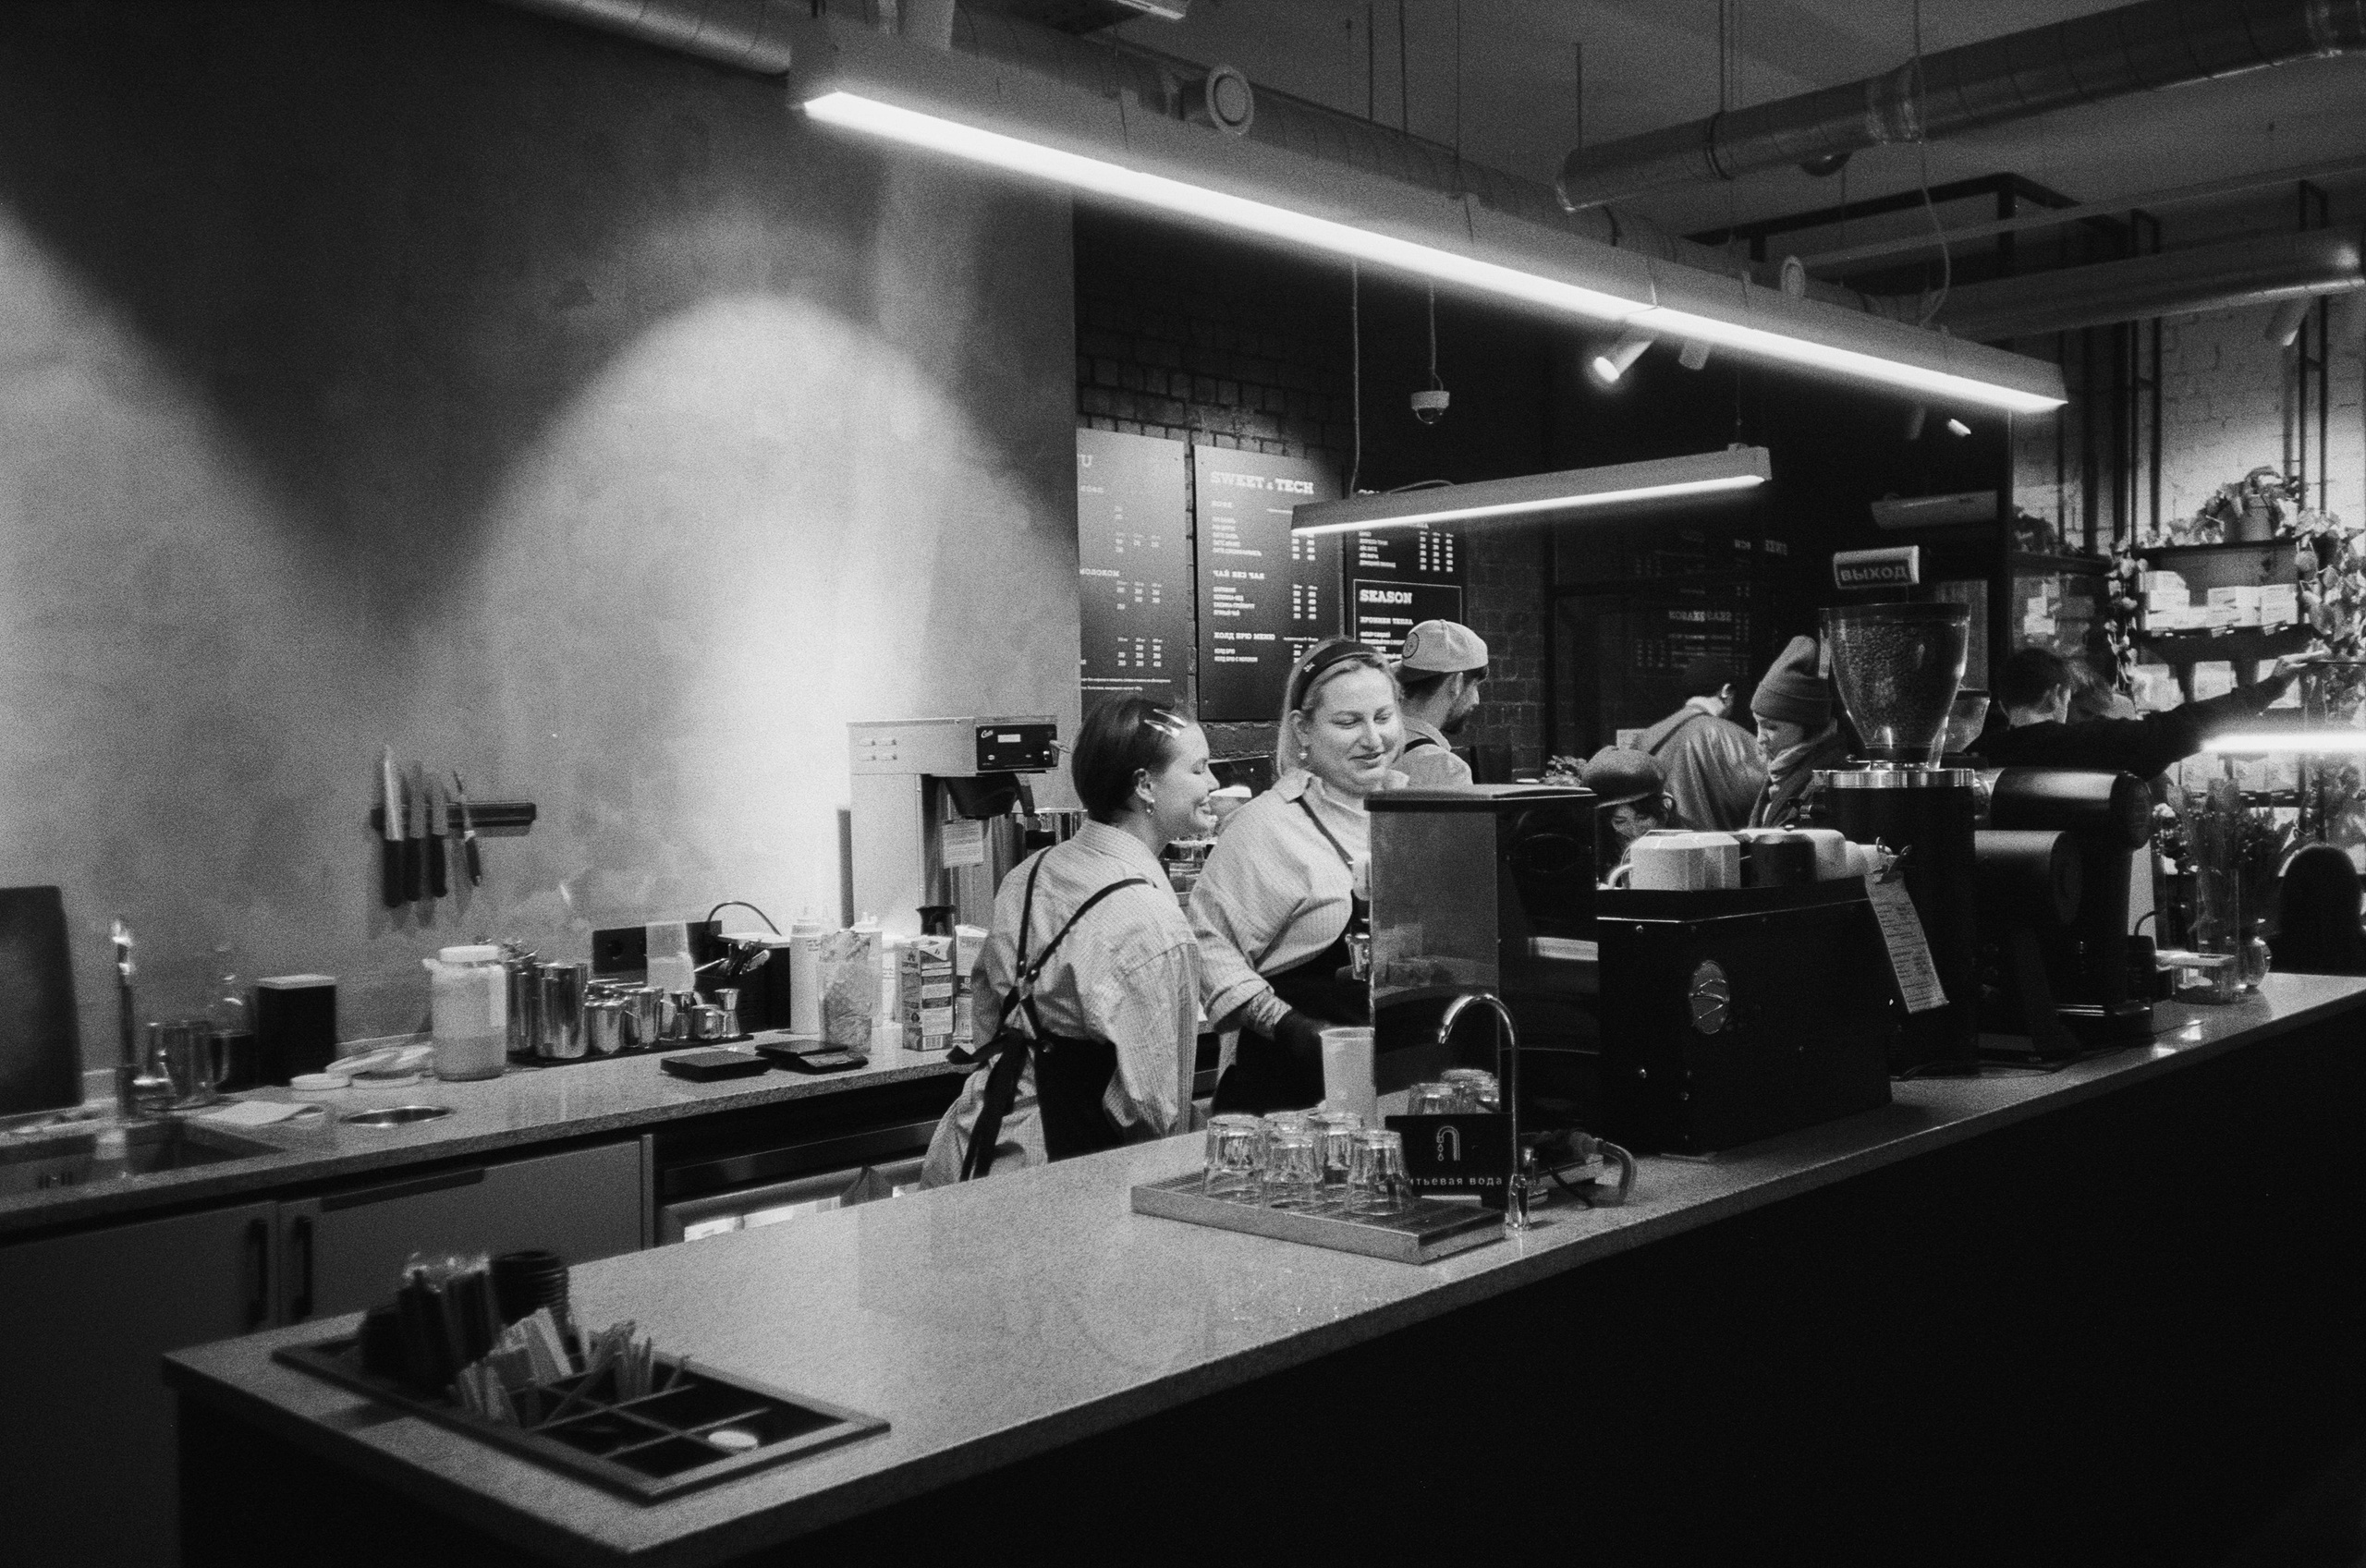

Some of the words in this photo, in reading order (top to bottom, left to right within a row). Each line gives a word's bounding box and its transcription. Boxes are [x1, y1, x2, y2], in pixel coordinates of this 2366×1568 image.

[1210, 471, 1264, 489] SWEET
[1274, 478, 1314, 494] TECH
[1840, 565, 1909, 581] ВЫХОД
[1359, 590, 1412, 604] SEASON
[1409, 1177, 1463, 1185] тьевая
[1470, 1177, 1503, 1186] вода
